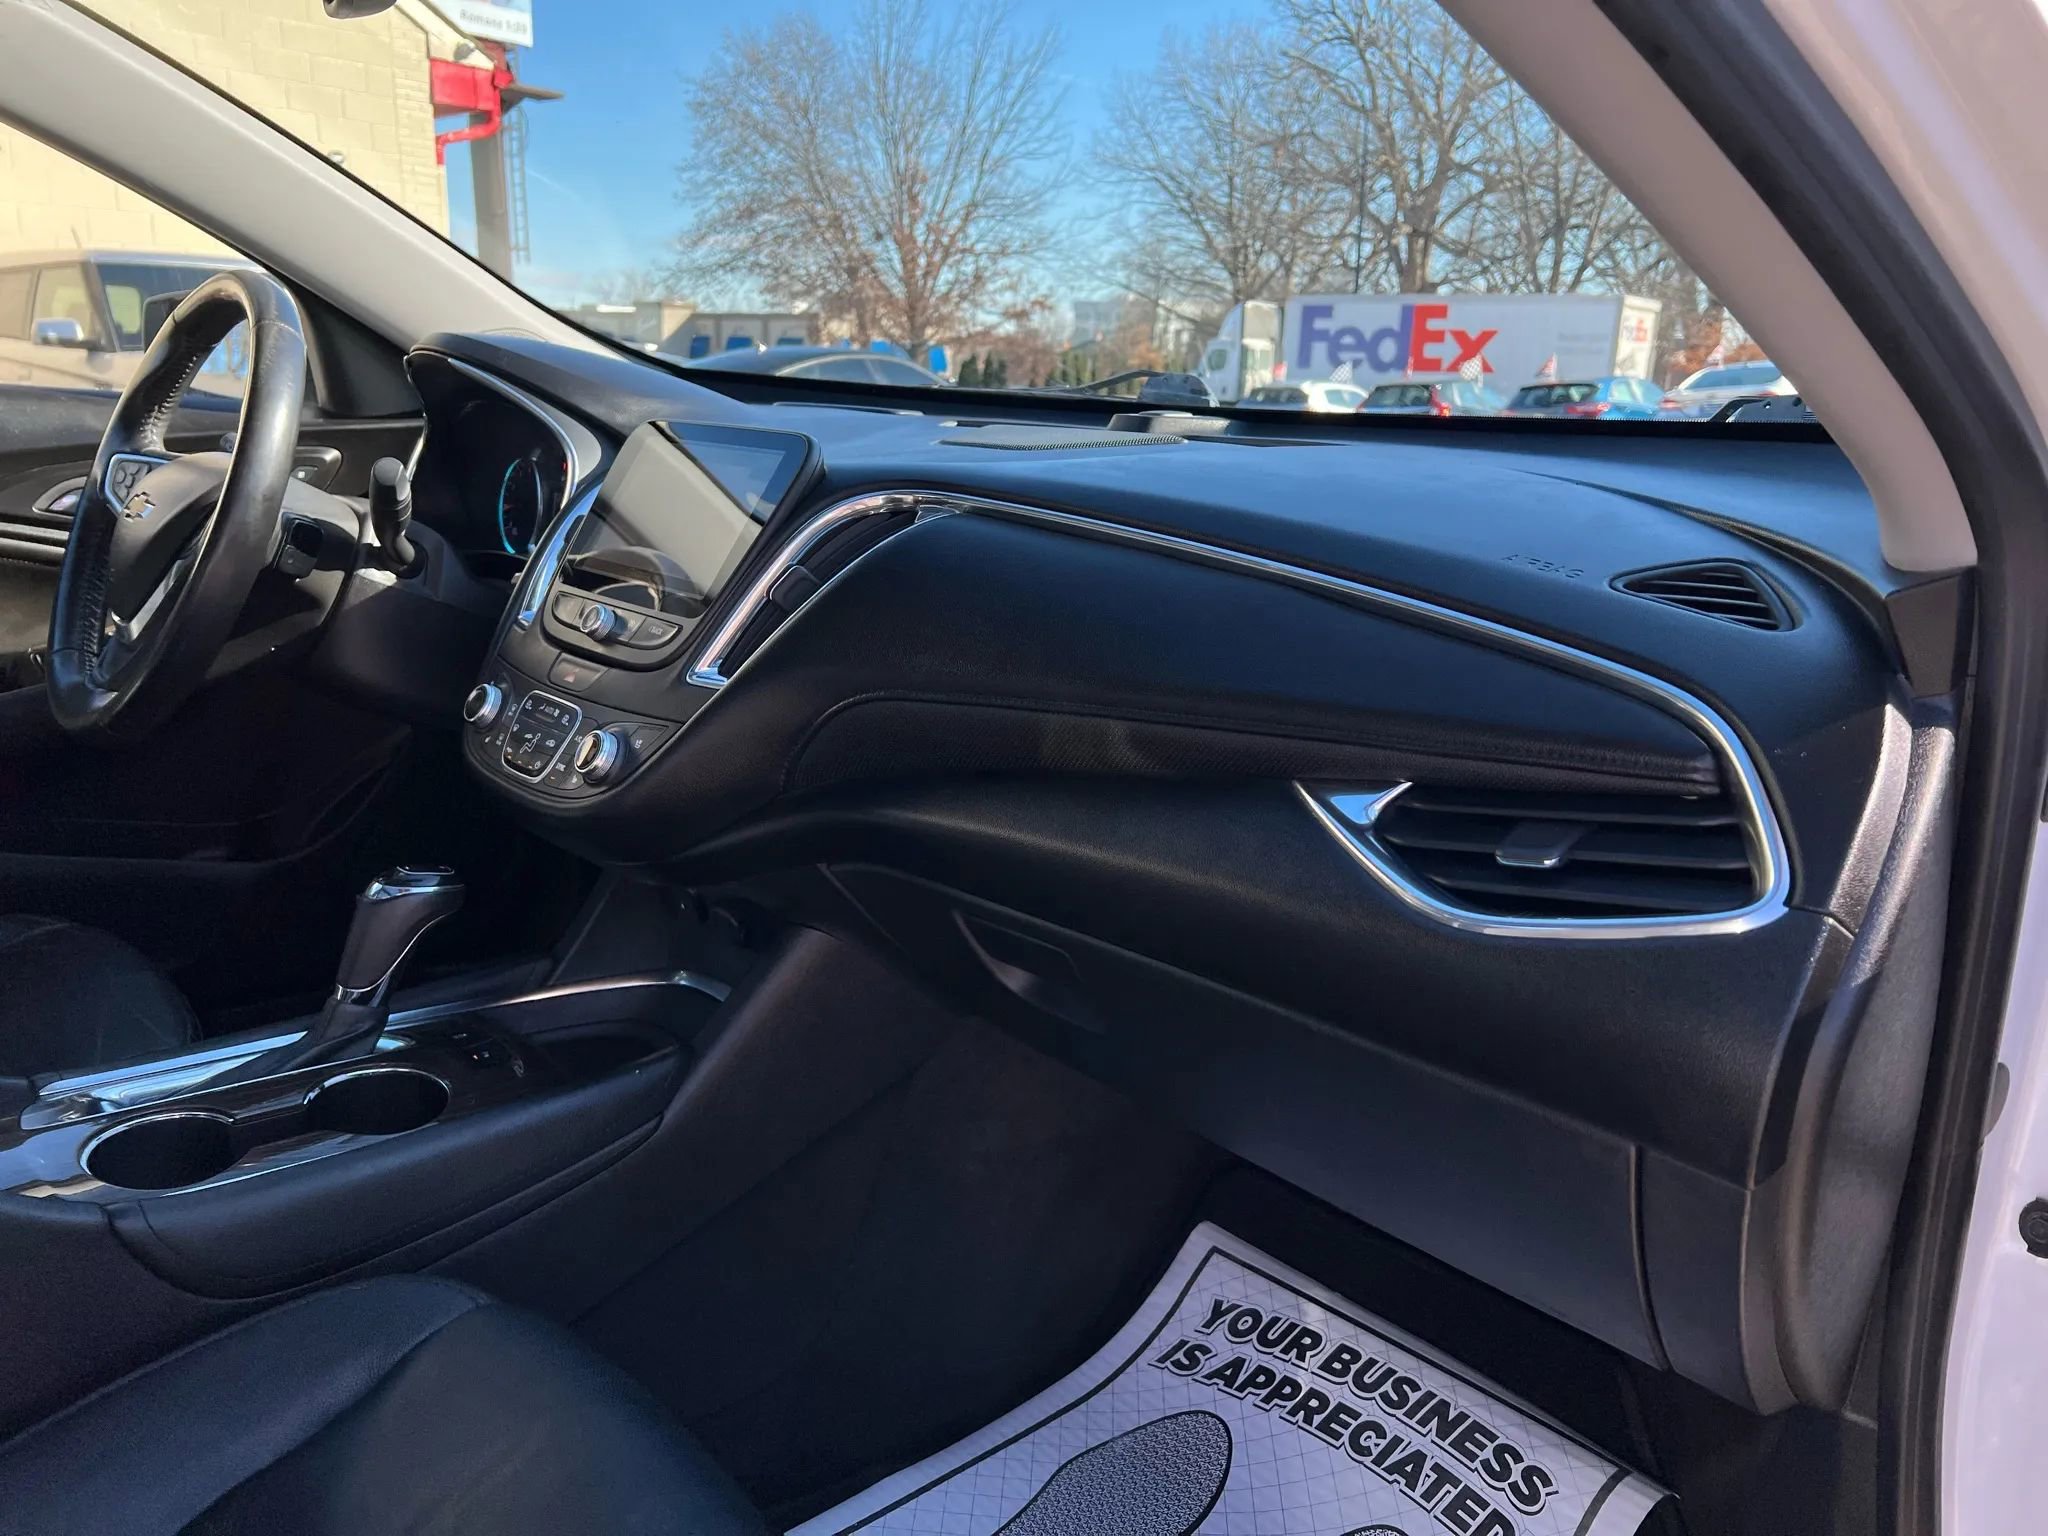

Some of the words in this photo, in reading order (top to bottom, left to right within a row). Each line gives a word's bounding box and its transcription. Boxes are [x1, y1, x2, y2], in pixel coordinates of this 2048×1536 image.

[1300, 304, 1499, 373] FedEx
[1151, 1338, 1214, 1374] IS
[1200, 1354, 1518, 1536] APPRECIATED
[1198, 1297, 1326, 1367] YOUR
[1316, 1341, 1556, 1511] BUSINESS
